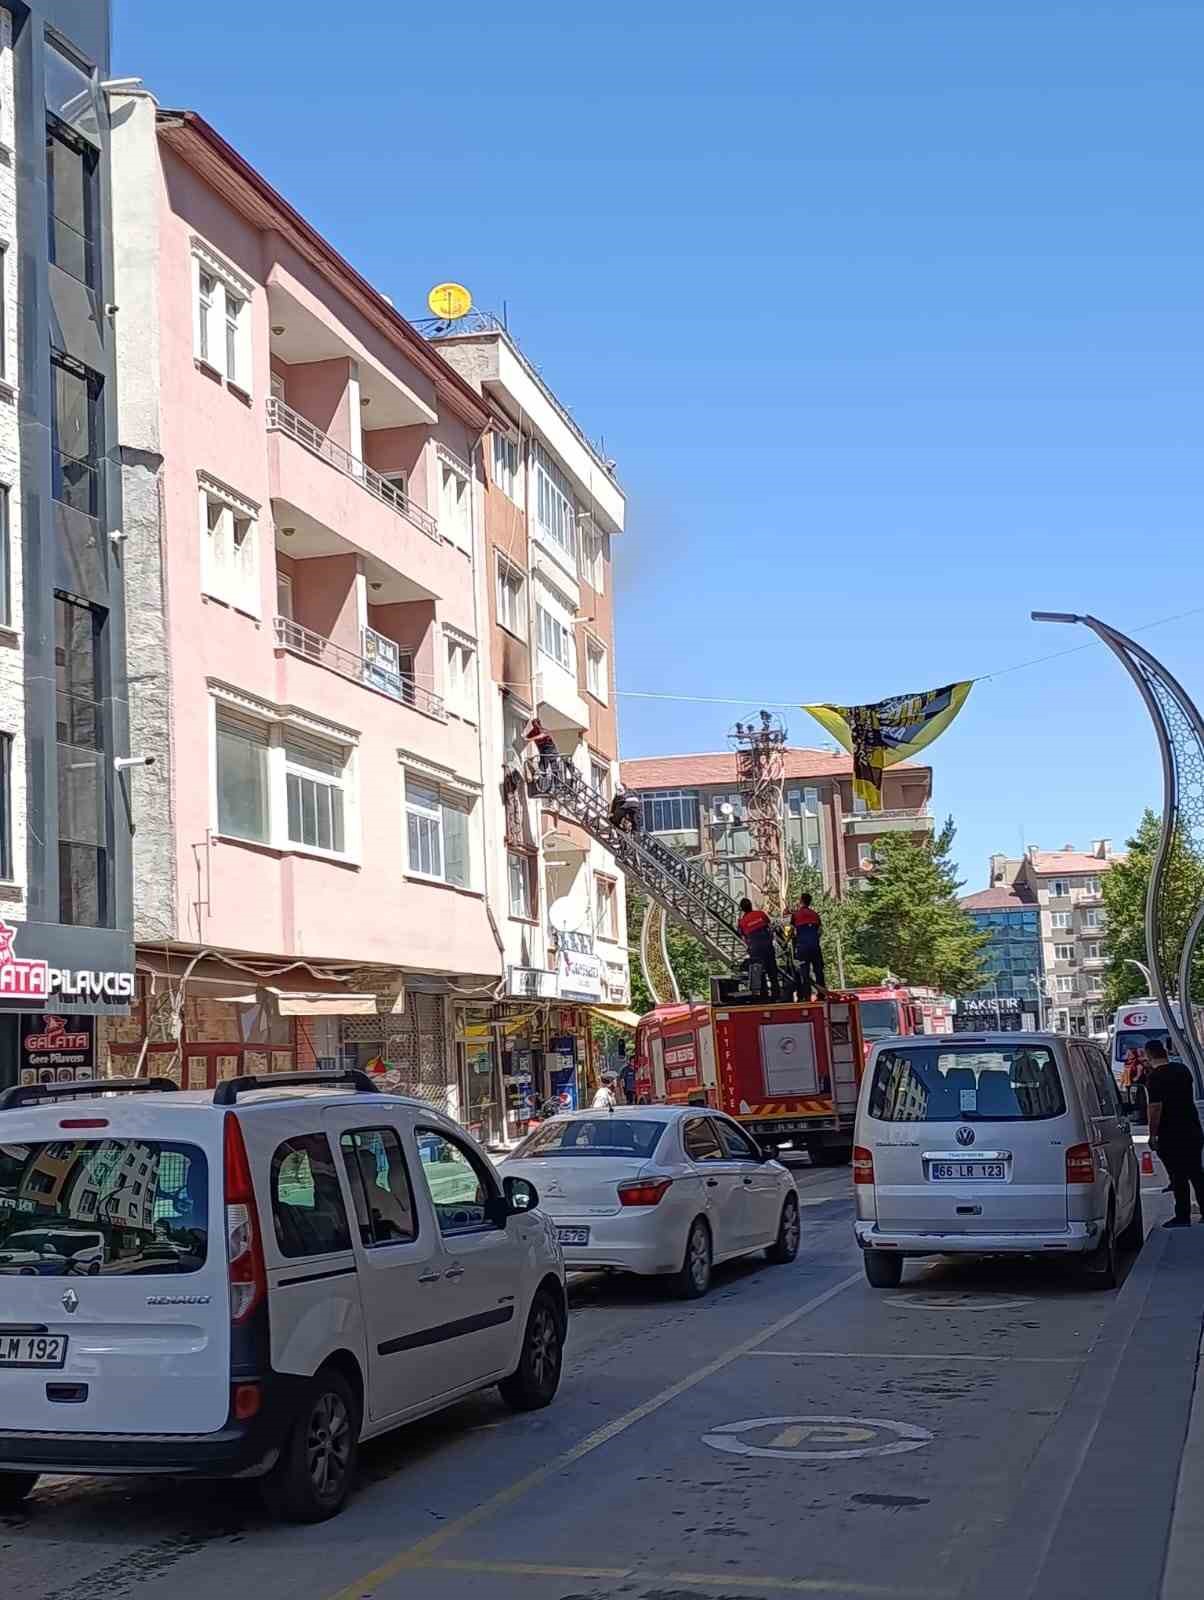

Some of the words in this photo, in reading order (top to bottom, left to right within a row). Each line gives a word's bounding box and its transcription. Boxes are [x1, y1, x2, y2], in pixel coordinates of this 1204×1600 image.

[27, 1035, 88, 1049] GALATA
[940, 1166, 952, 1177] 66
[960, 1166, 973, 1177] LR
[982, 1166, 1001, 1177] 123
[147, 1295, 212, 1305] RENAULT
[28, 1338, 59, 1360] 192
